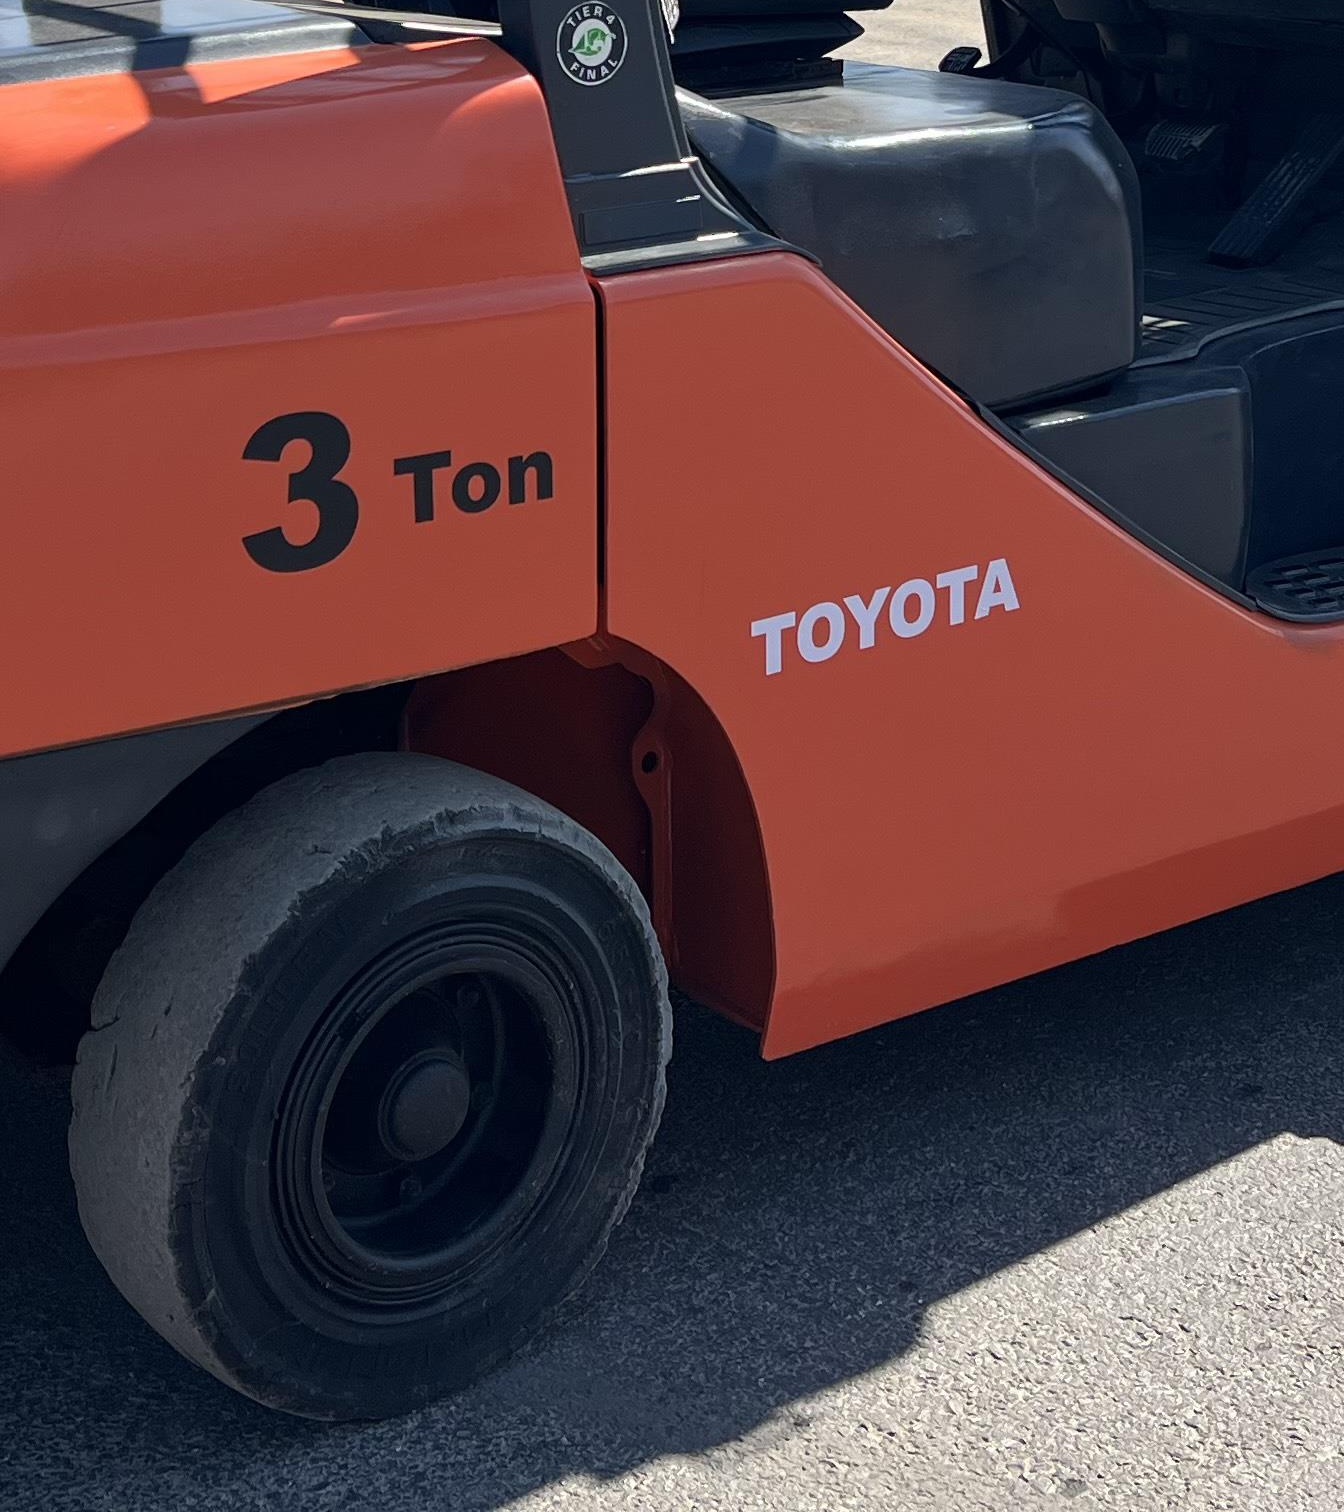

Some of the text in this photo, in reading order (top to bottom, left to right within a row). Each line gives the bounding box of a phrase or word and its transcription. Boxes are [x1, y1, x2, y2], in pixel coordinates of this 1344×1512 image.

[566, 5, 616, 27] TIER 4
[569, 59, 618, 80] FINAL
[241, 411, 553, 573] 3 Ton
[751, 558, 1020, 675] TOYOTA
